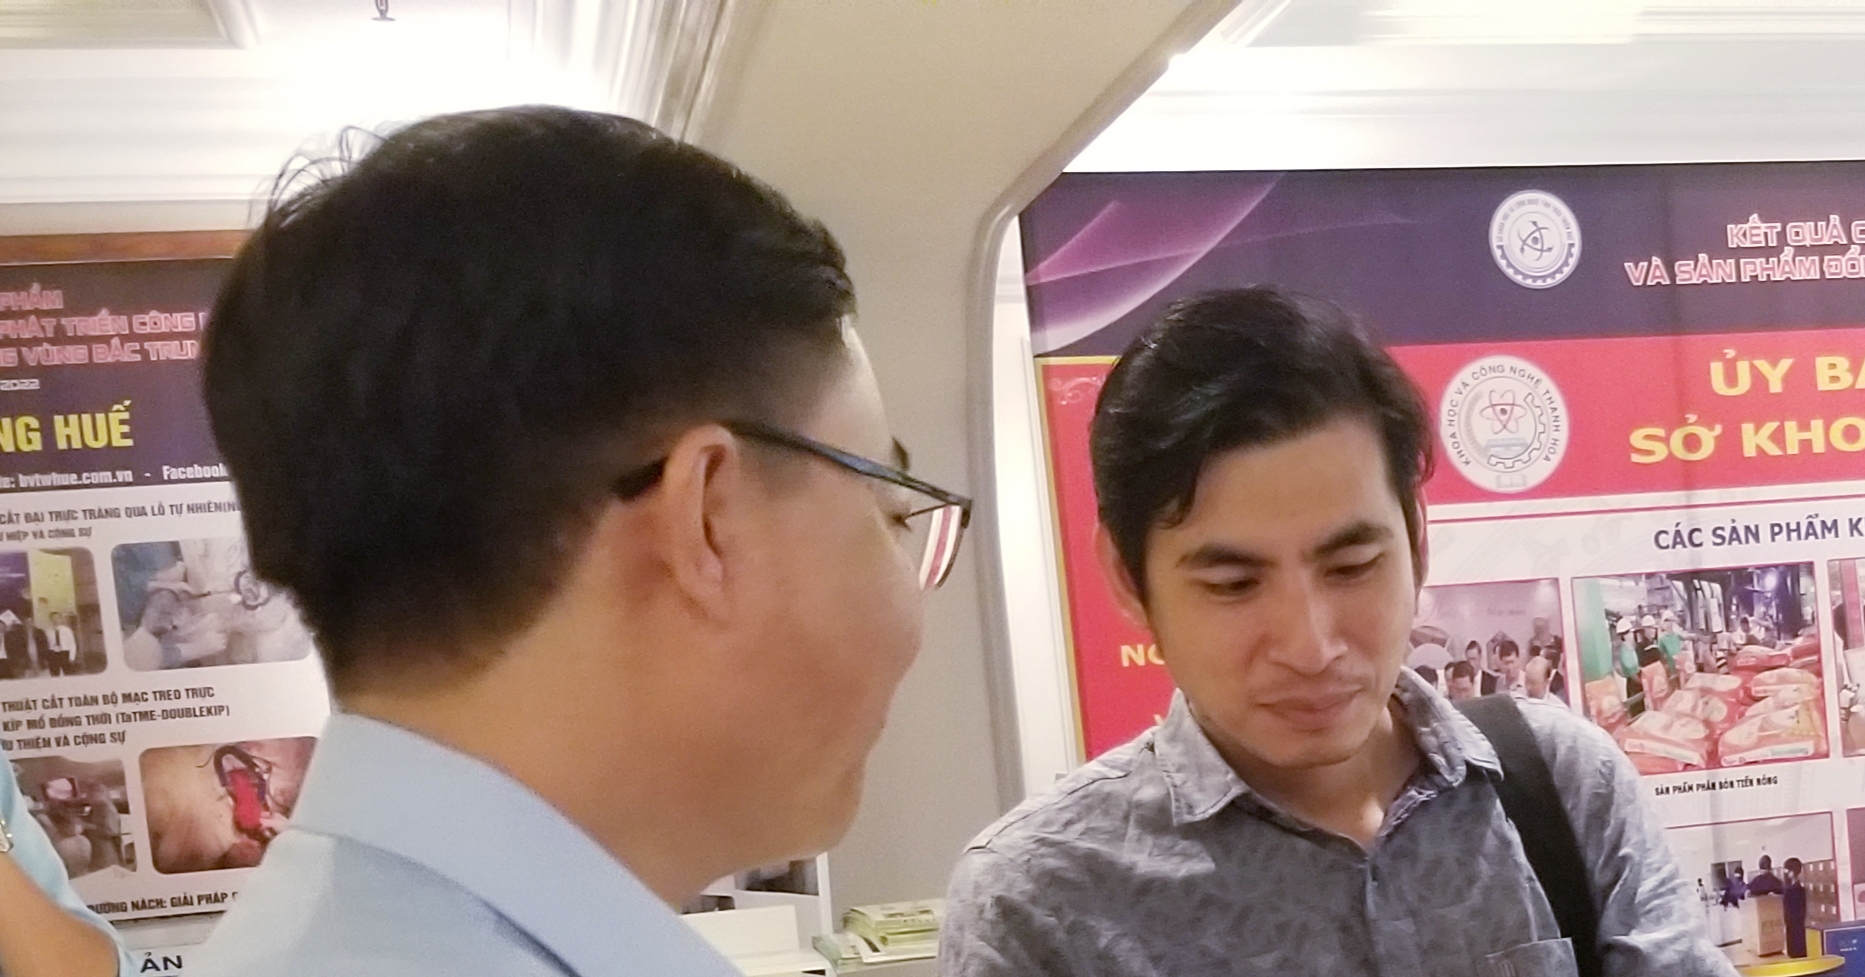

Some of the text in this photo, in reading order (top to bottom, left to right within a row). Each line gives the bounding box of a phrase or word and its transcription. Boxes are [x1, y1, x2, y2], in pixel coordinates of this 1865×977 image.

[1727, 213, 1781, 248] KẾT
[1786, 215, 1847, 247] QUẢ
[1624, 256, 1670, 286] VÀ
[1675, 253, 1736, 285] SẢN
[1740, 246, 1820, 283] PHẨM
[61, 308, 129, 336] TRIỂN
[132, 310, 196, 334] CÔNG
[21, 342, 89, 366] VÙNG
[92, 336, 142, 363] BẮC
[0, 378, 40, 391] 2022
[1709, 349, 1794, 397] ỦY
[0, 400, 134, 453] NG HUẾ
[1628, 414, 1723, 465] SỞ
[124, 506, 148, 518] QUA
[1653, 521, 1704, 552] CÁC
[1711, 517, 1761, 548] SẢN
[1770, 512, 1840, 544] PHẨM
[151, 689, 181, 701] TREO
[140, 951, 183, 973] ẢN
